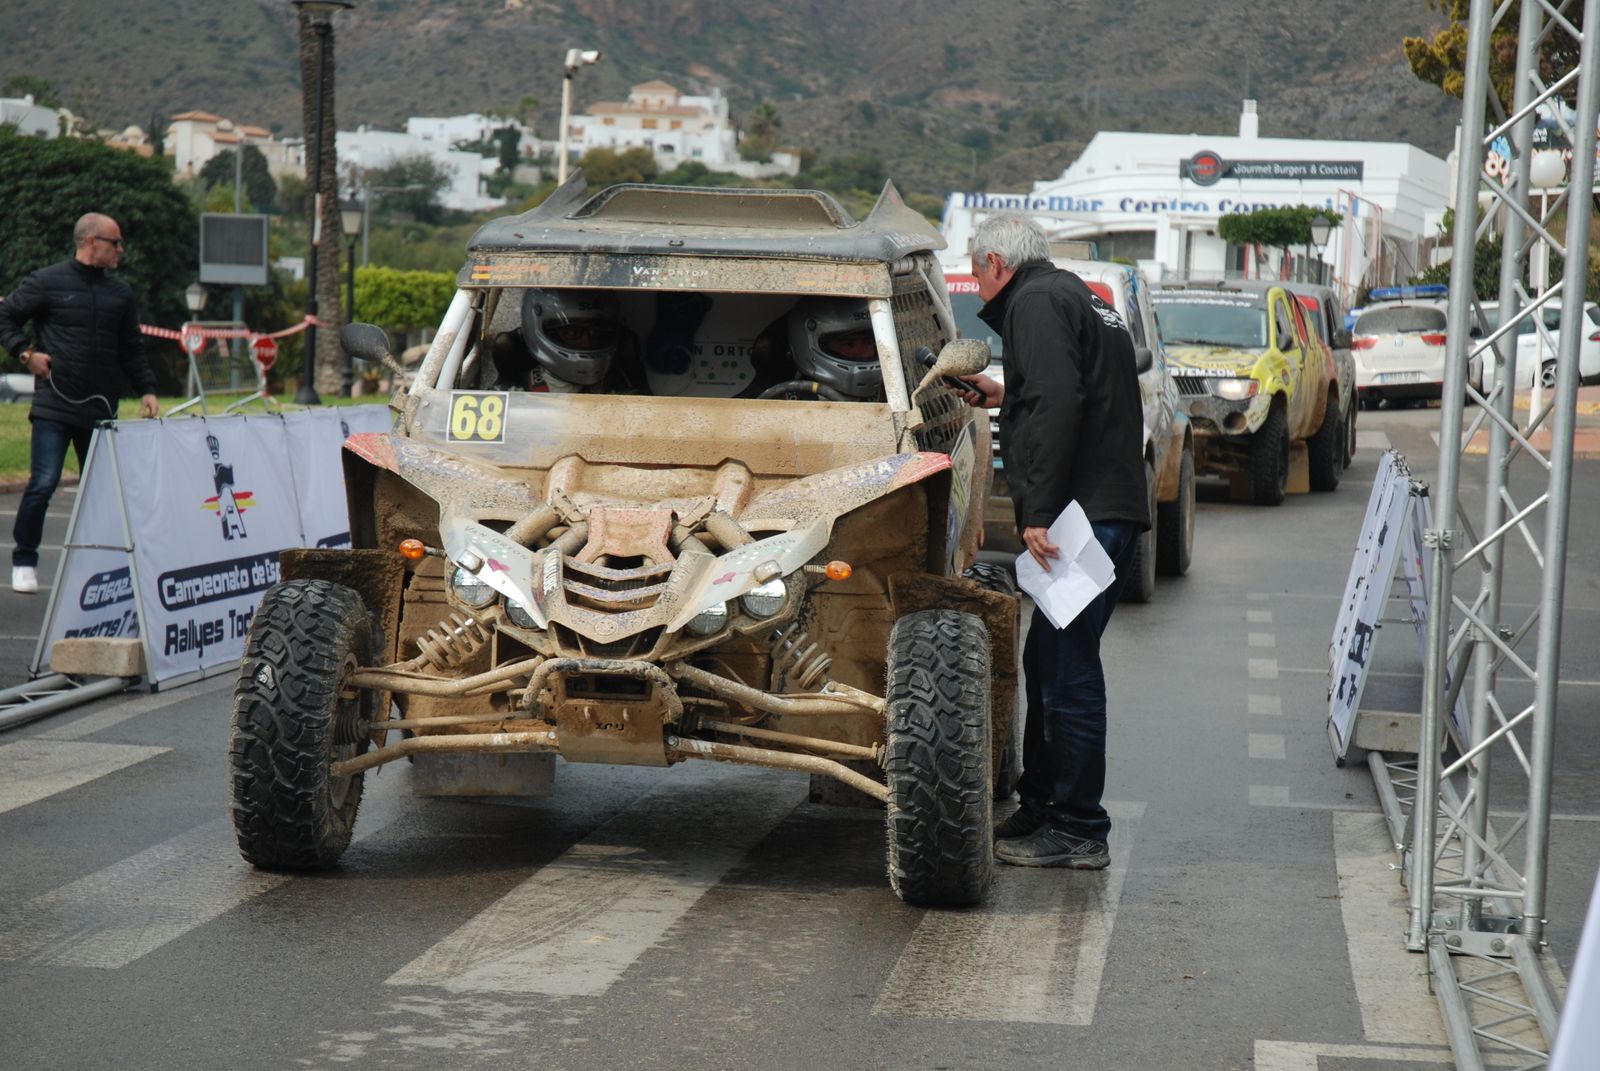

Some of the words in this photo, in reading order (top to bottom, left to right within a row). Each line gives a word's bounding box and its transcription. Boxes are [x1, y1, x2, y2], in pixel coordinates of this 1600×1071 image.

[1274, 164, 1307, 176] Burgers
[1310, 165, 1317, 174] &
[1319, 164, 1358, 175] Cocktails
[451, 395, 503, 440] 68
[162, 564, 250, 605] Campeonato
[251, 561, 265, 587] de
[164, 618, 224, 659] Rallyes
